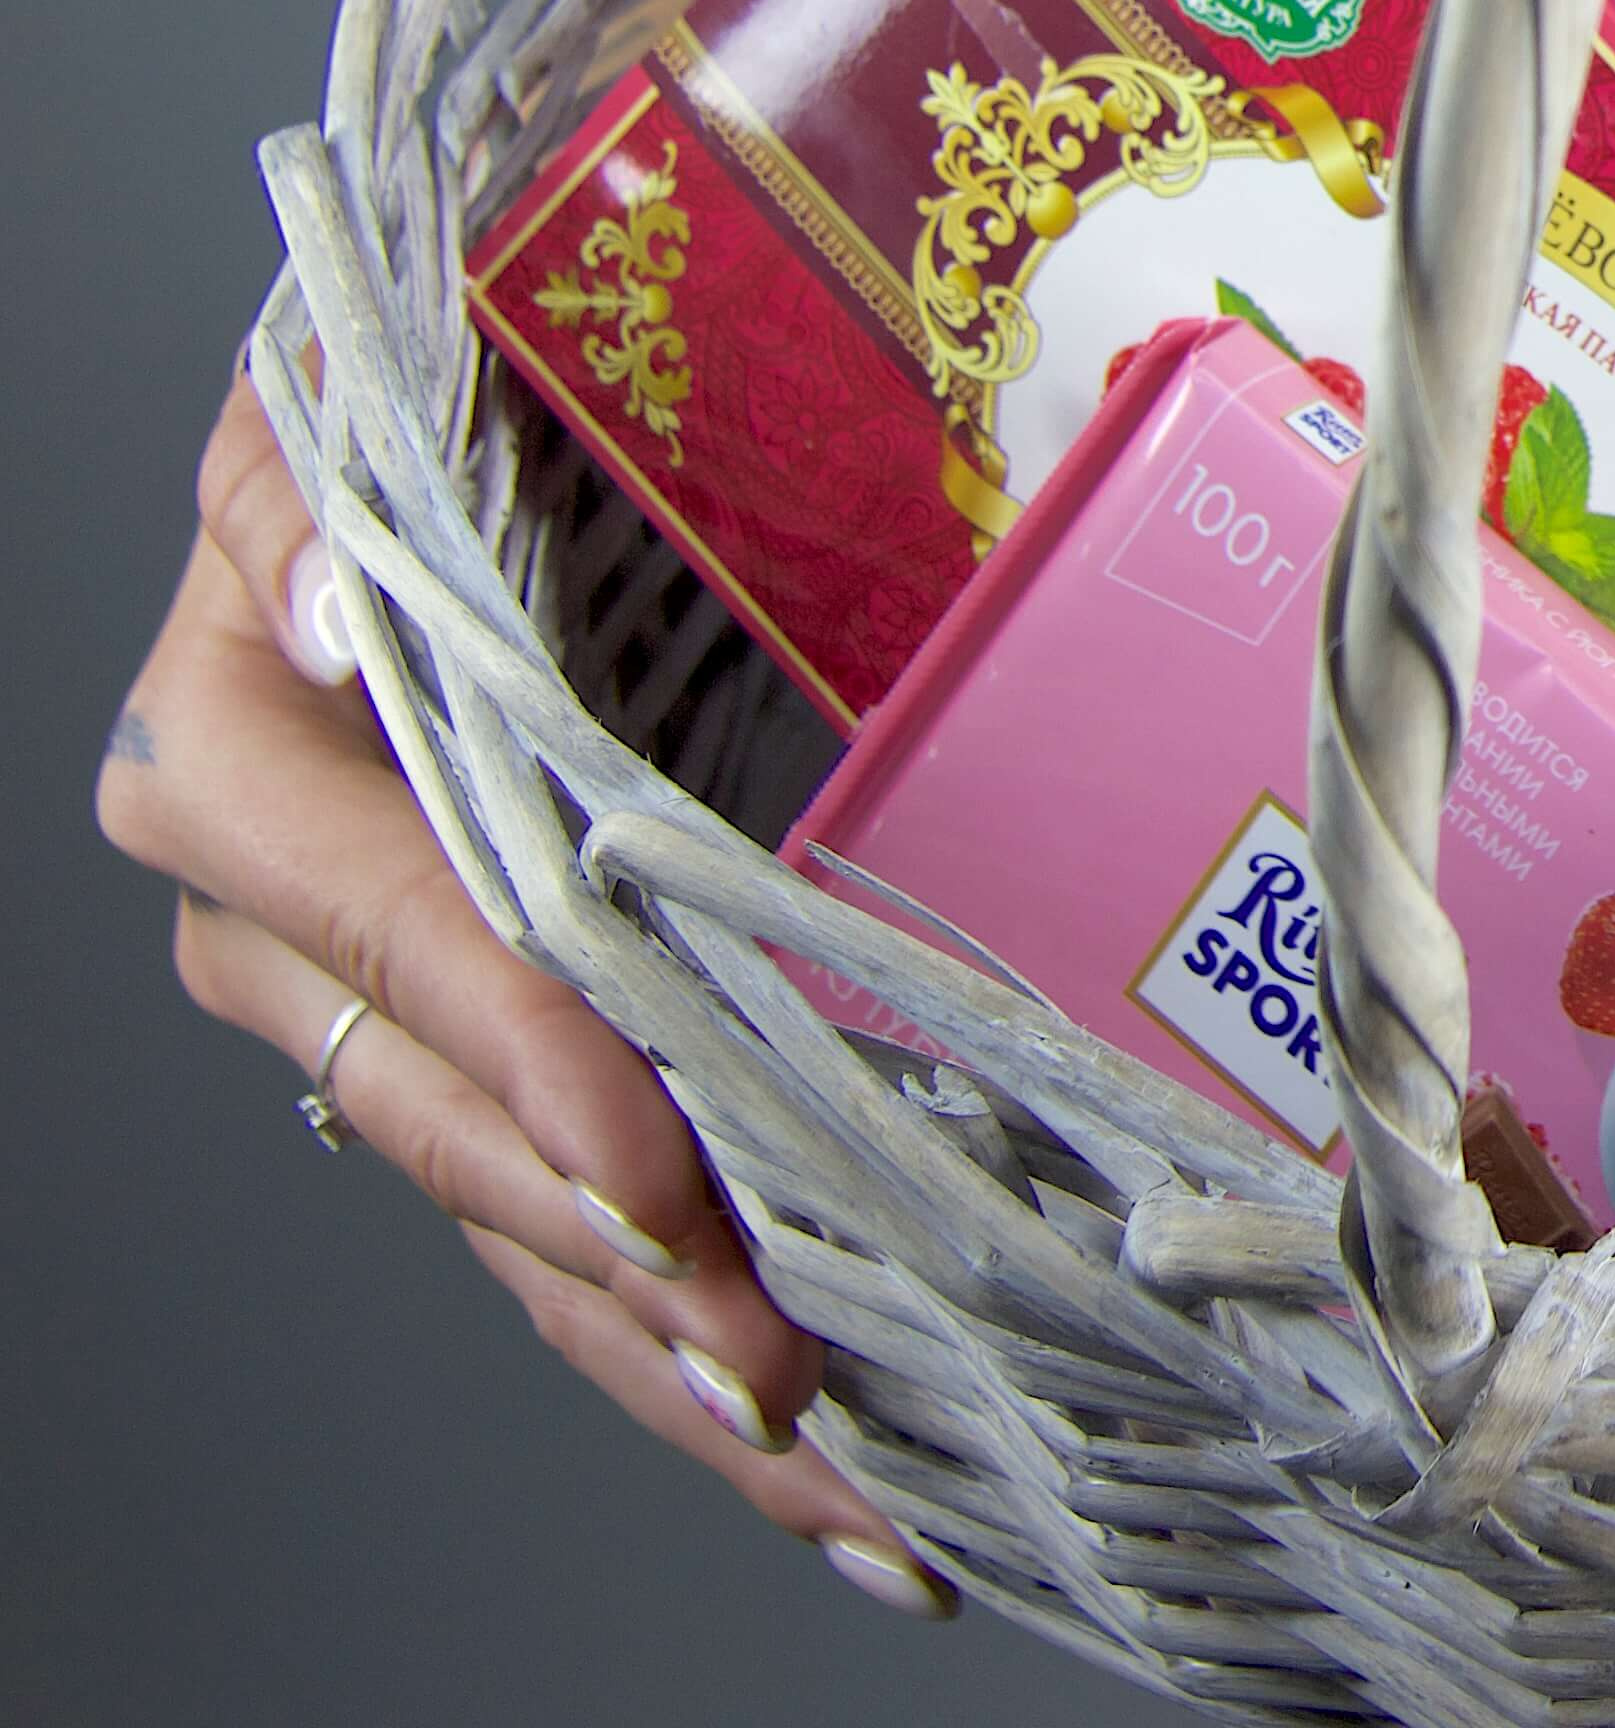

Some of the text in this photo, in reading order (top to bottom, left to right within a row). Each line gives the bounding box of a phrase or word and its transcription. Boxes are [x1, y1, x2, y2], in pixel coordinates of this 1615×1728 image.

[1172, 462, 1297, 589] 100 г
[1183, 927, 1330, 1089] SPOR
